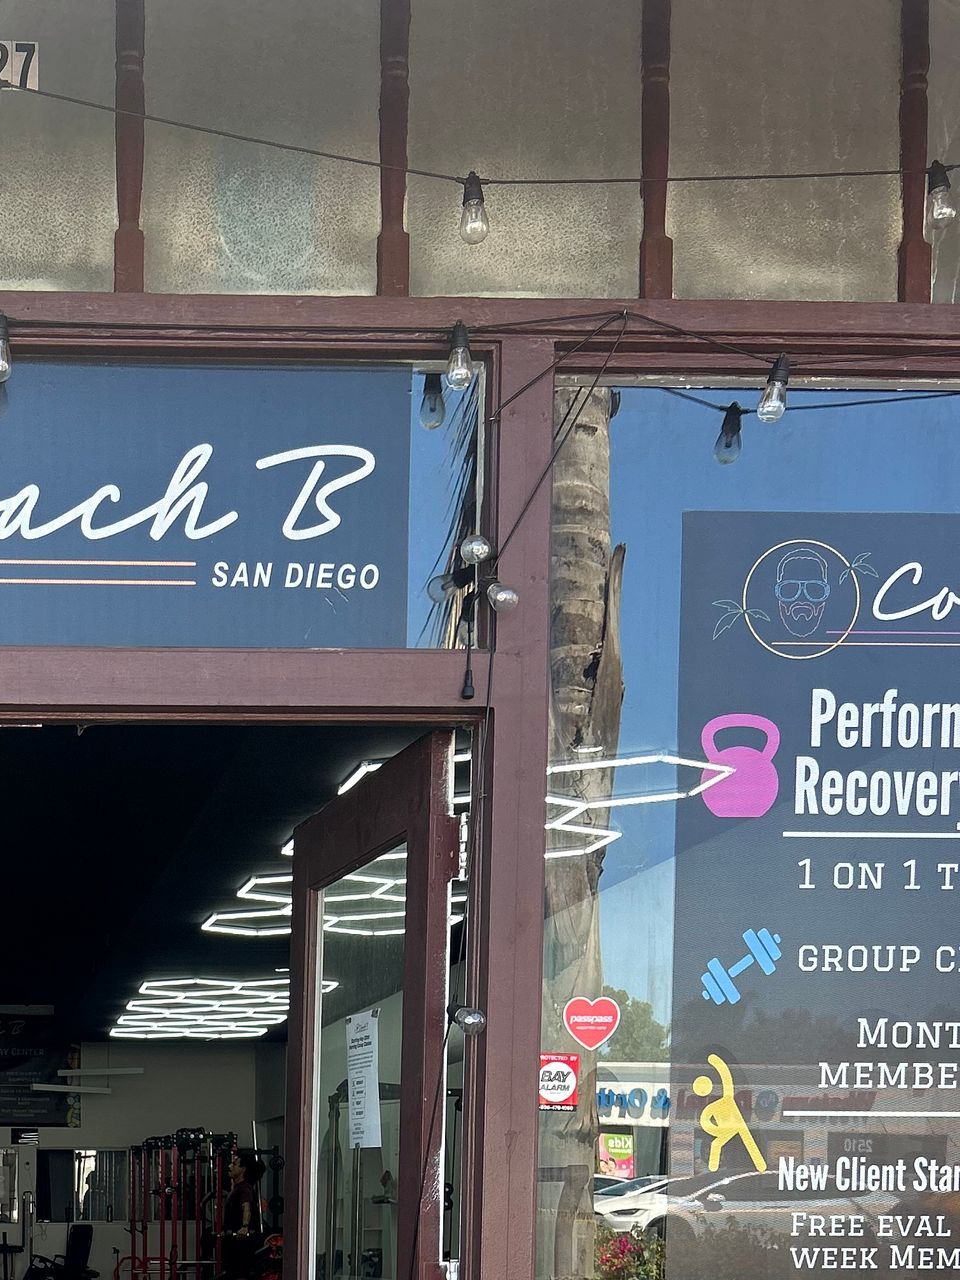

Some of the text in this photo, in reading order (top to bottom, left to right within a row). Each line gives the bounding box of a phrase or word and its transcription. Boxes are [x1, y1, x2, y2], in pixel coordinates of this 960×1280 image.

[255, 444, 377, 541] B
[211, 561, 380, 590] SAN DIEGO
[798, 858, 816, 889] 1
[833, 862, 885, 889] ON
[903, 859, 921, 890] 1
[798, 944, 921, 973] GROUP
[8, 1020, 25, 1035] B
[570, 1015, 614, 1024] passpass
[540, 1084, 571, 1092] ALARM
[541, 1070, 572, 1083] BAY
[818, 1062, 958, 1089] MEMBE
[778, 1156, 829, 1191] New
[836, 1156, 906, 1191] Client
[790, 1212, 951, 1238] FREE EVAL
[790, 1245, 960, 1270] WEEK MEM
